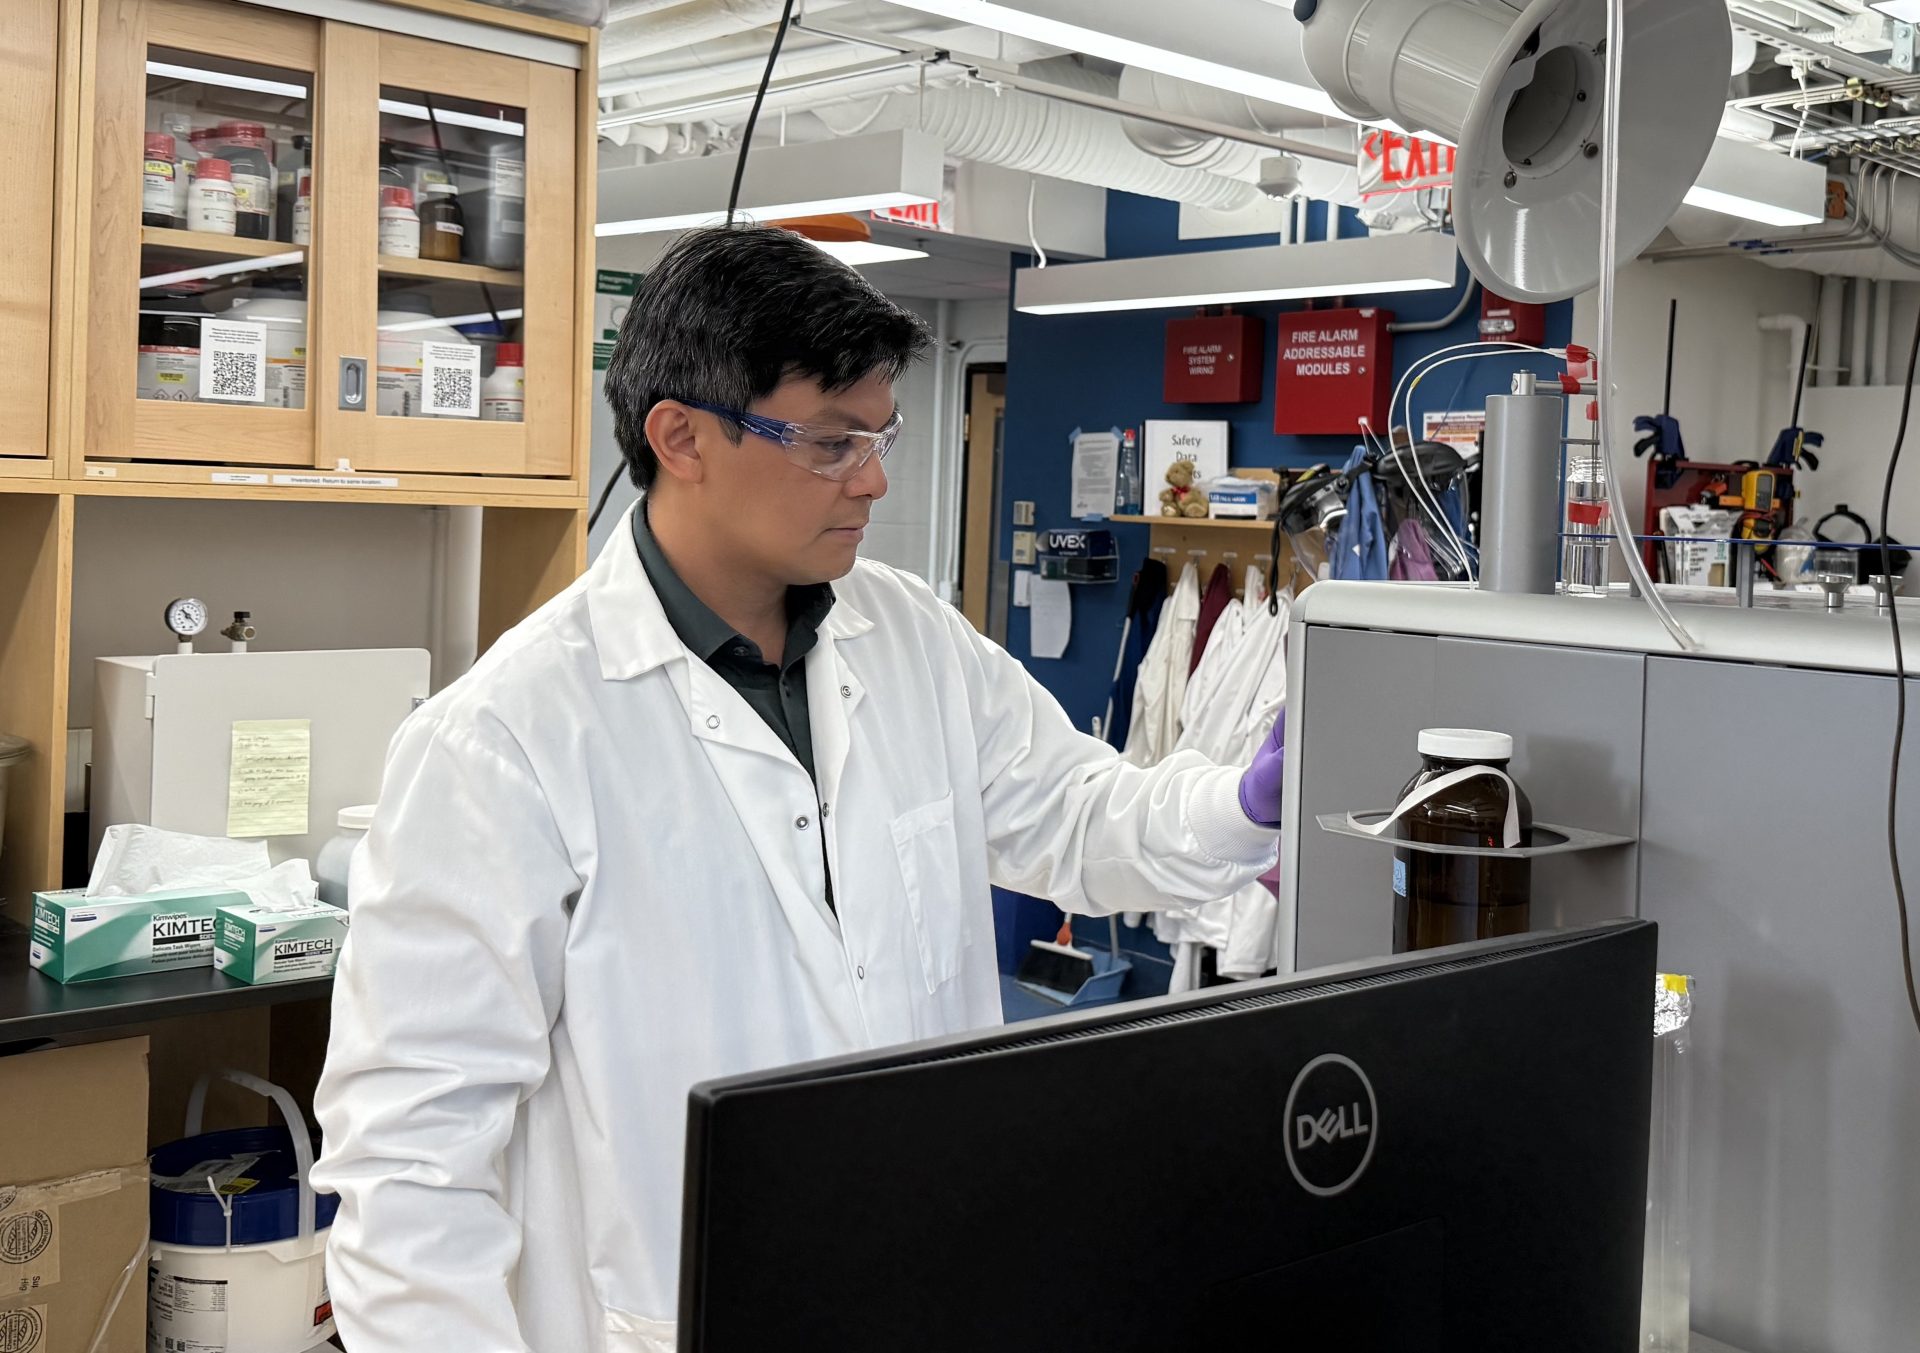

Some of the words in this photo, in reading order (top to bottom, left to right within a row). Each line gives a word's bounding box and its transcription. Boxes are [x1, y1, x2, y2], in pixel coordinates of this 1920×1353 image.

[1292, 331, 1316, 343] FIRE
[1318, 329, 1358, 341] ALARM
[1199, 345, 1221, 353] ALARM
[1283, 345, 1365, 360] ADDRESSABLE
[1189, 356, 1215, 365] SYSTEM
[1189, 366, 1214, 376] WIRING
[1296, 362, 1350, 376] MODULES
[1171, 434, 1201, 447] Safety
[1176, 451, 1197, 463] Data
[1049, 535, 1085, 549] UVEX
[153, 914, 187, 922] Kimwipes
[153, 918, 216, 937] KIMTE
[274, 939, 333, 954] KIMTECH
[1297, 1102, 1368, 1149] DELL
